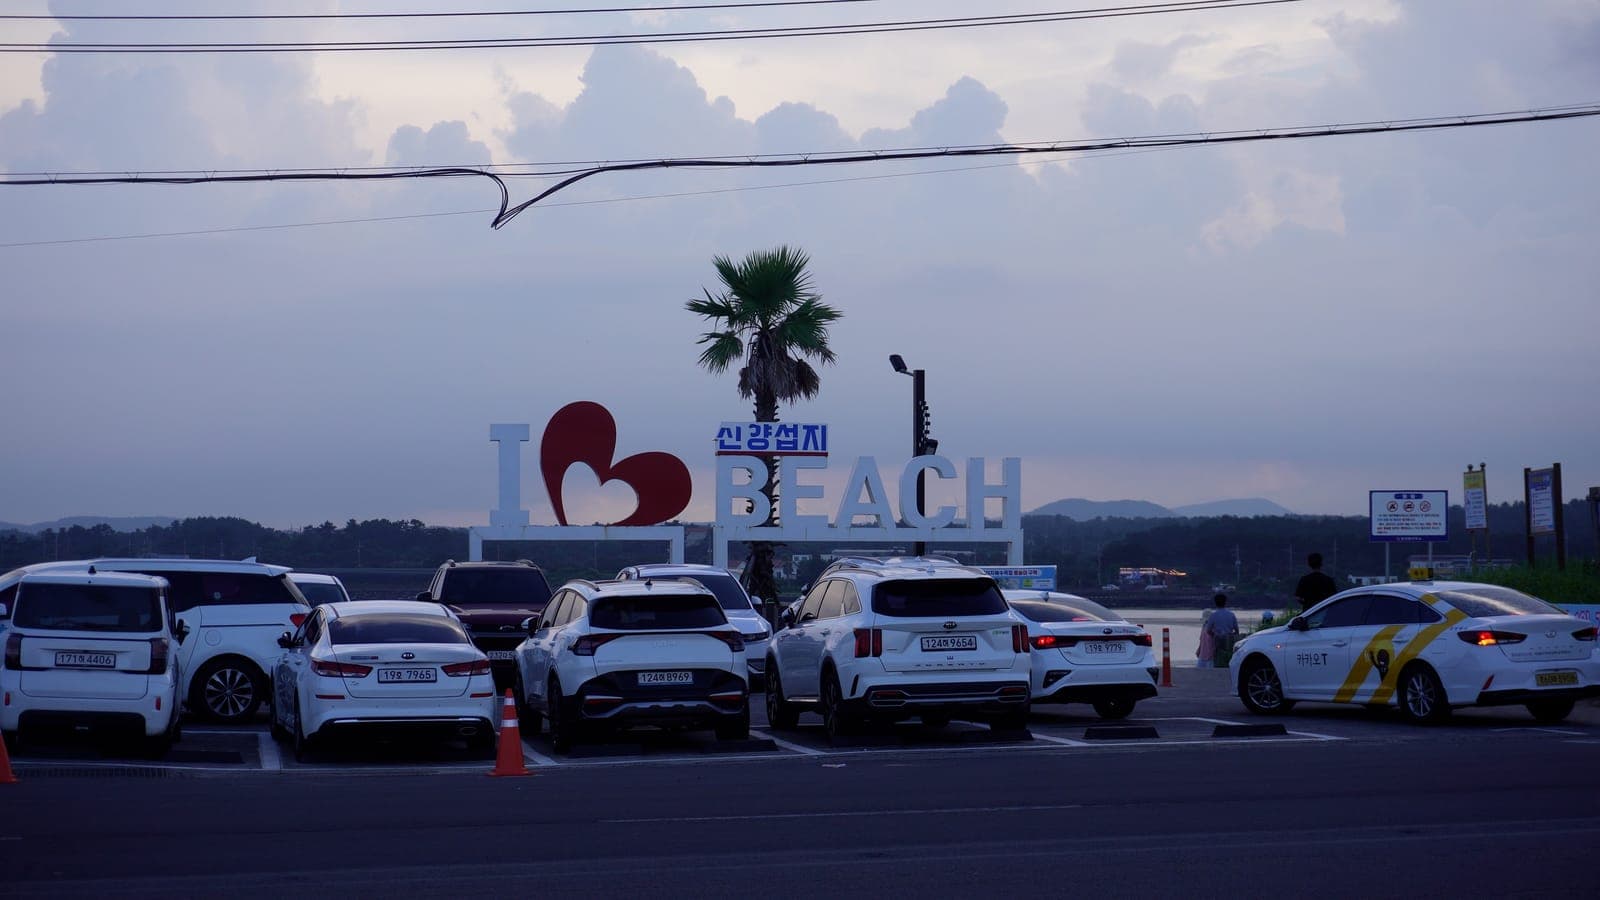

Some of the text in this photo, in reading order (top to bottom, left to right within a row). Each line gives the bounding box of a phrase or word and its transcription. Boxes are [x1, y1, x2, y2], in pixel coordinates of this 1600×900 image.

[716, 423, 828, 452] 신양섭지
[489, 423, 1022, 530] I BEACH
[406, 670, 431, 679] 7965
